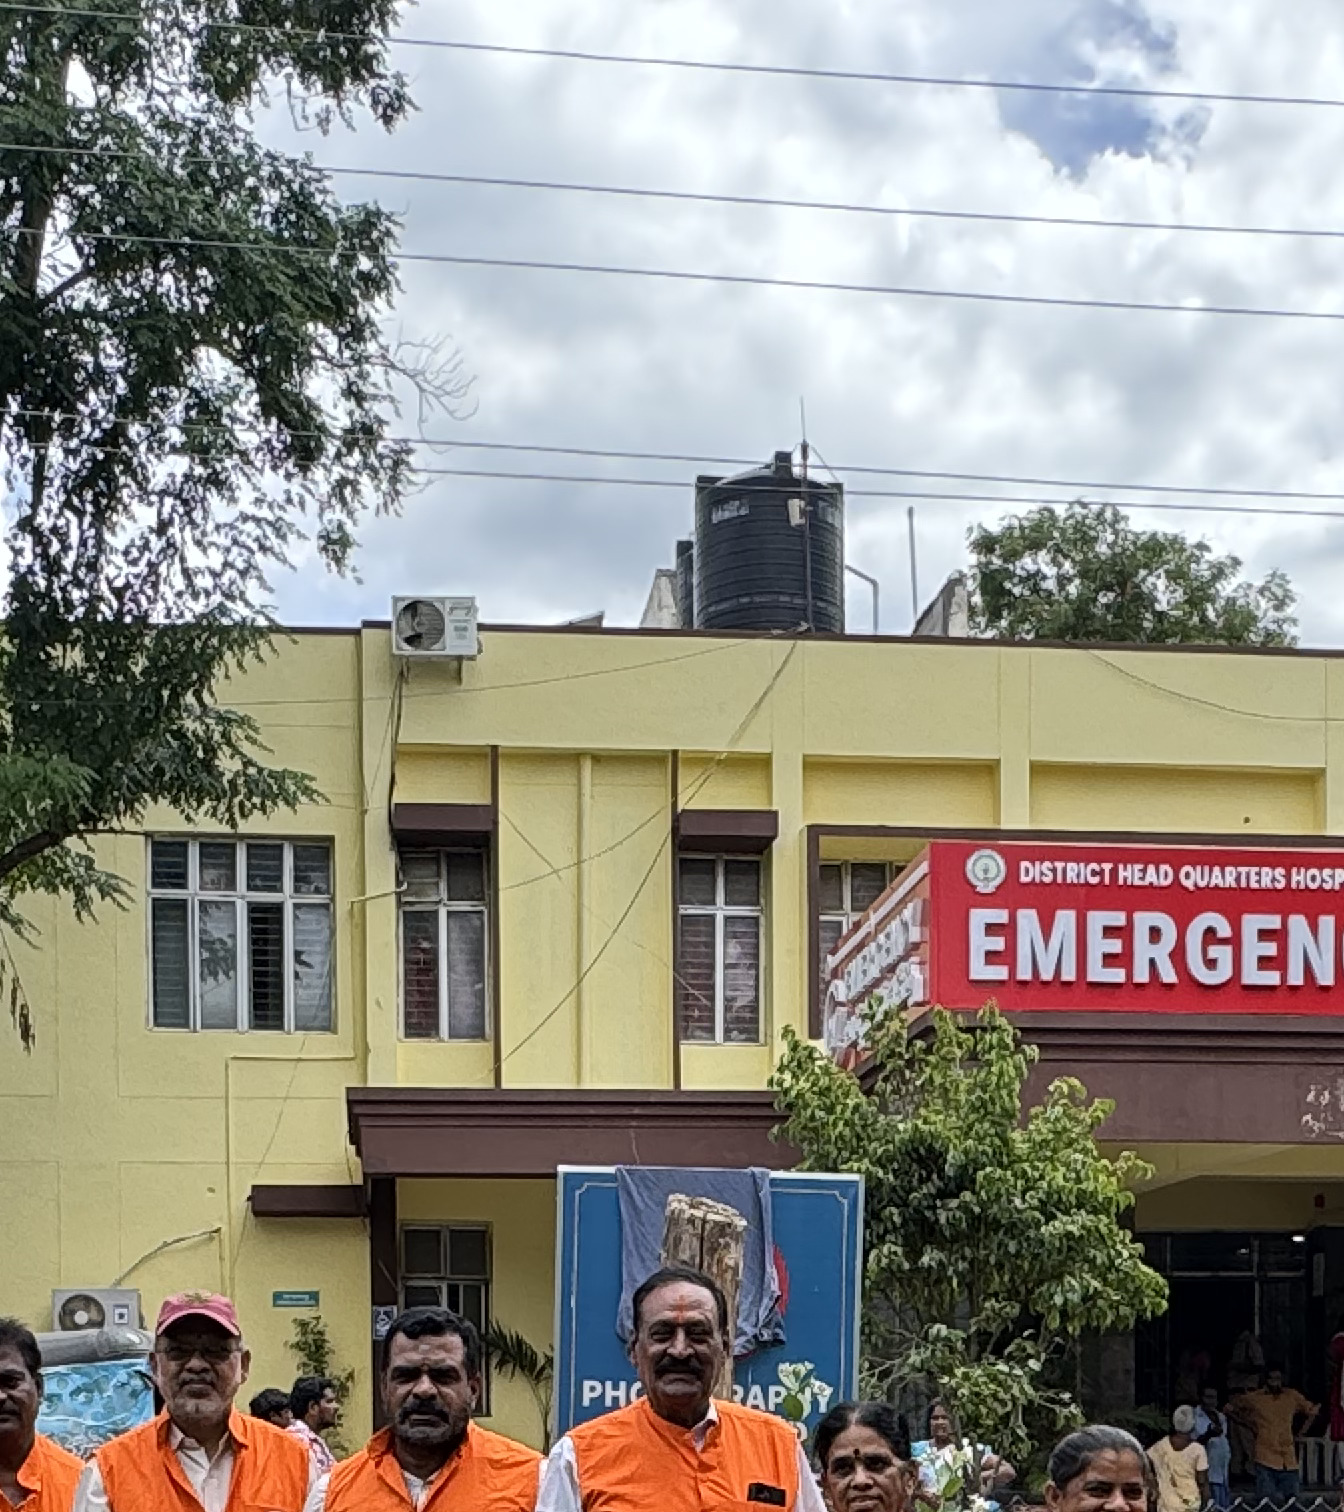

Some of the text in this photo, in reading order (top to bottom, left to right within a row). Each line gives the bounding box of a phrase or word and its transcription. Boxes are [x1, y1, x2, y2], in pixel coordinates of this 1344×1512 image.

[1019, 860, 1115, 886] DISTRICT
[1118, 864, 1174, 887] HEAD
[1179, 865, 1287, 890] QUARTERS
